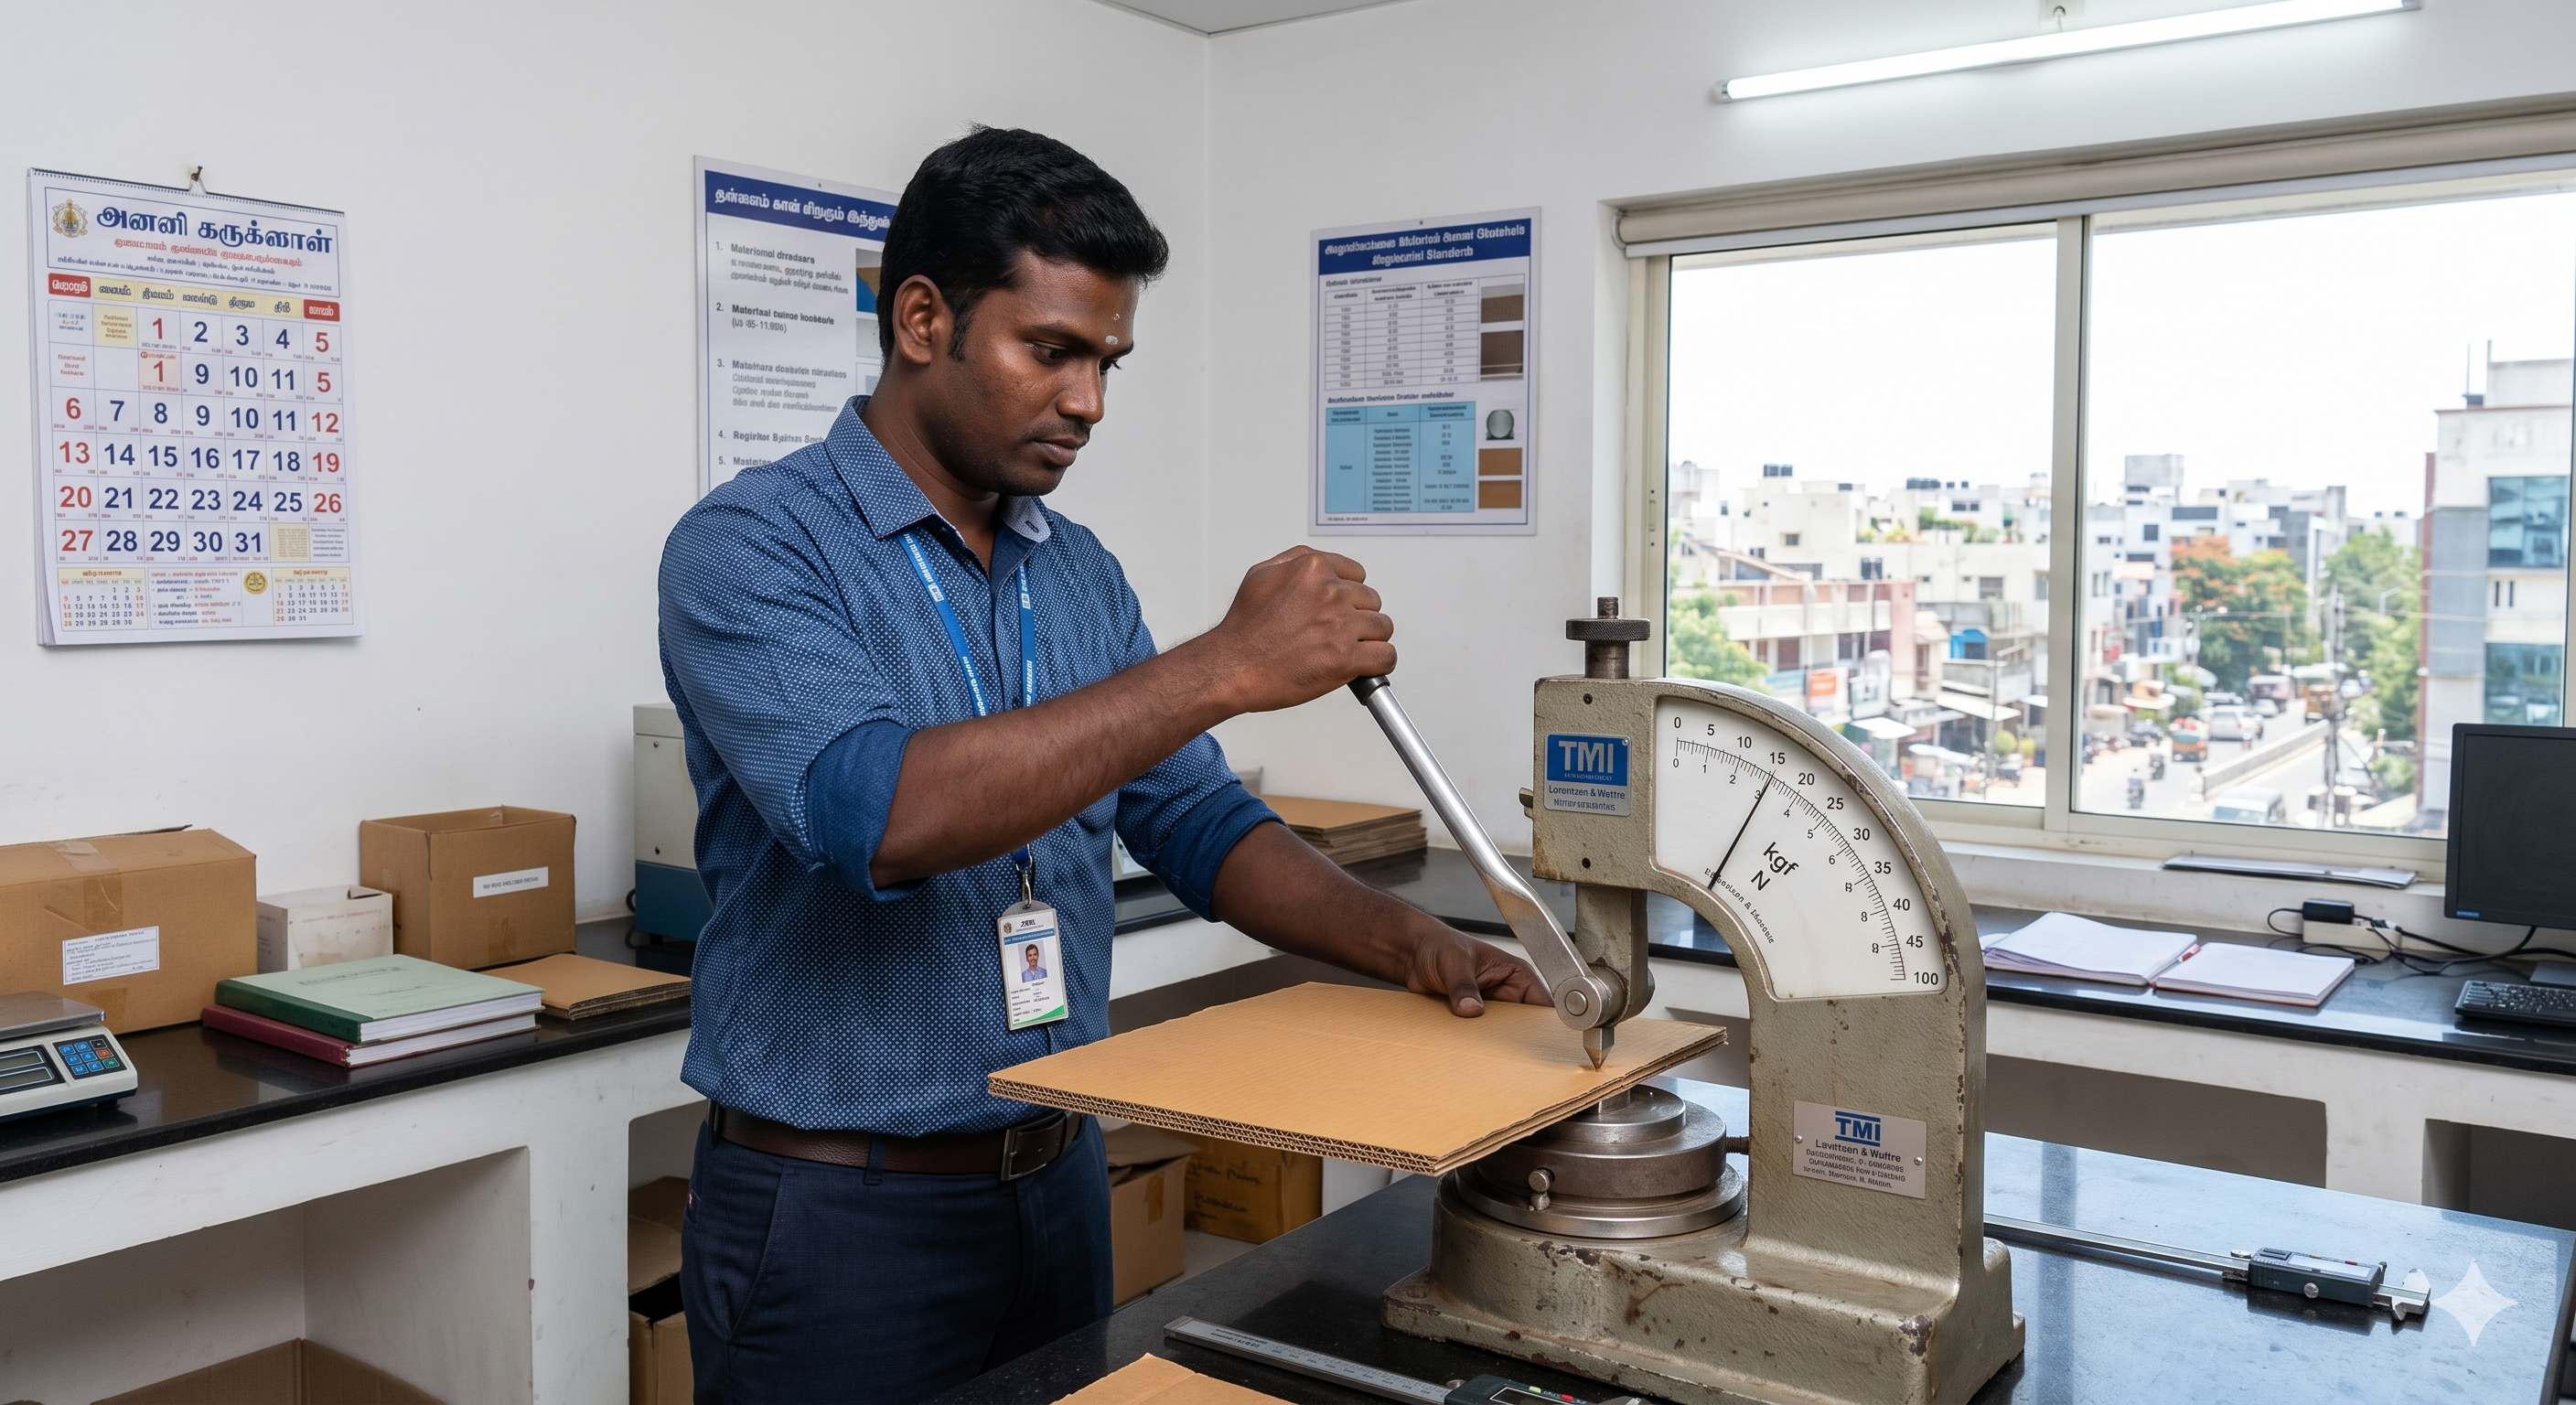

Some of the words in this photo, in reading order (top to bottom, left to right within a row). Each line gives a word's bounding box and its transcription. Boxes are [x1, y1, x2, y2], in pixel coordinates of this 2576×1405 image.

[716, 302, 724, 311] 2.
[153, 318, 162, 339] 1
[194, 321, 208, 342] 2
[236, 325, 249, 346] 3
[276, 329, 289, 349] 4
[316, 332, 328, 352] 5
[717, 359, 724, 368] 3.
[154, 360, 163, 381] 1
[196, 364, 209, 384] 9
[231, 366, 257, 388] 10
[272, 370, 294, 390] 11
[317, 372, 330, 392] 5
[67, 398, 80, 419] 6
[111, 401, 124, 421] 7
[155, 402, 167, 424] 8
[197, 405, 209, 425] 9
[231, 408, 258, 429] 10
[274, 411, 295, 431] 11
[312, 413, 338, 433] 12
[718, 431, 726, 439] 4.
[60, 442, 90, 464] 13
[105, 444, 134, 465] 14
[149, 445, 177, 467] 15
[191, 447, 220, 468] 16
[232, 449, 260, 469] 17
[274, 452, 300, 471] 18
[313, 453, 339, 472] 19
[60, 486, 91, 508] 20
[105, 488, 132, 509] 21
[149, 488, 178, 509] 22
[192, 489, 220, 510] 23
[233, 491, 263, 510] 24
[274, 492, 302, 512] 25
[315, 493, 341, 513] 26
[62, 530, 92, 551] 27
[107, 531, 137, 552] 28
[151, 531, 180, 552] 29
[194, 531, 222, 552] 30
[235, 532, 260, 552] 31
[1674, 717, 1680, 728] 0
[1708, 724, 1714, 735] 5
[1738, 736, 1751, 748] 10
[1559, 741, 1614, 774] TMI
[1673, 758, 1679, 767] 0
[1770, 752, 1785, 764] 15
[1703, 765, 1706, 773] 1
[1730, 775, 1735, 784] 2
[1798, 773, 1814, 785] 20
[1549, 785, 1588, 796] Lorentzen
[1590, 788, 1595, 797] &
[1597, 789, 1625, 799] Wettre
[1828, 798, 1843, 810] 25
[1784, 810, 1789, 818] 4
[1808, 829, 1815, 839] 5
[1854, 828, 1870, 841] 30
[1763, 842, 1799, 875] kgf
[1830, 855, 1835, 864] 6
[1874, 862, 1891, 874] 35
[1751, 870, 1771, 891] N
[1894, 898, 1910, 910] 40
[1862, 912, 1867, 922] 8
[1906, 936, 1923, 948] 45
[1915, 971, 1938, 985] 100
[1835, 1117, 1881, 1142] TMI
[1862, 1148, 1868, 1156] &
